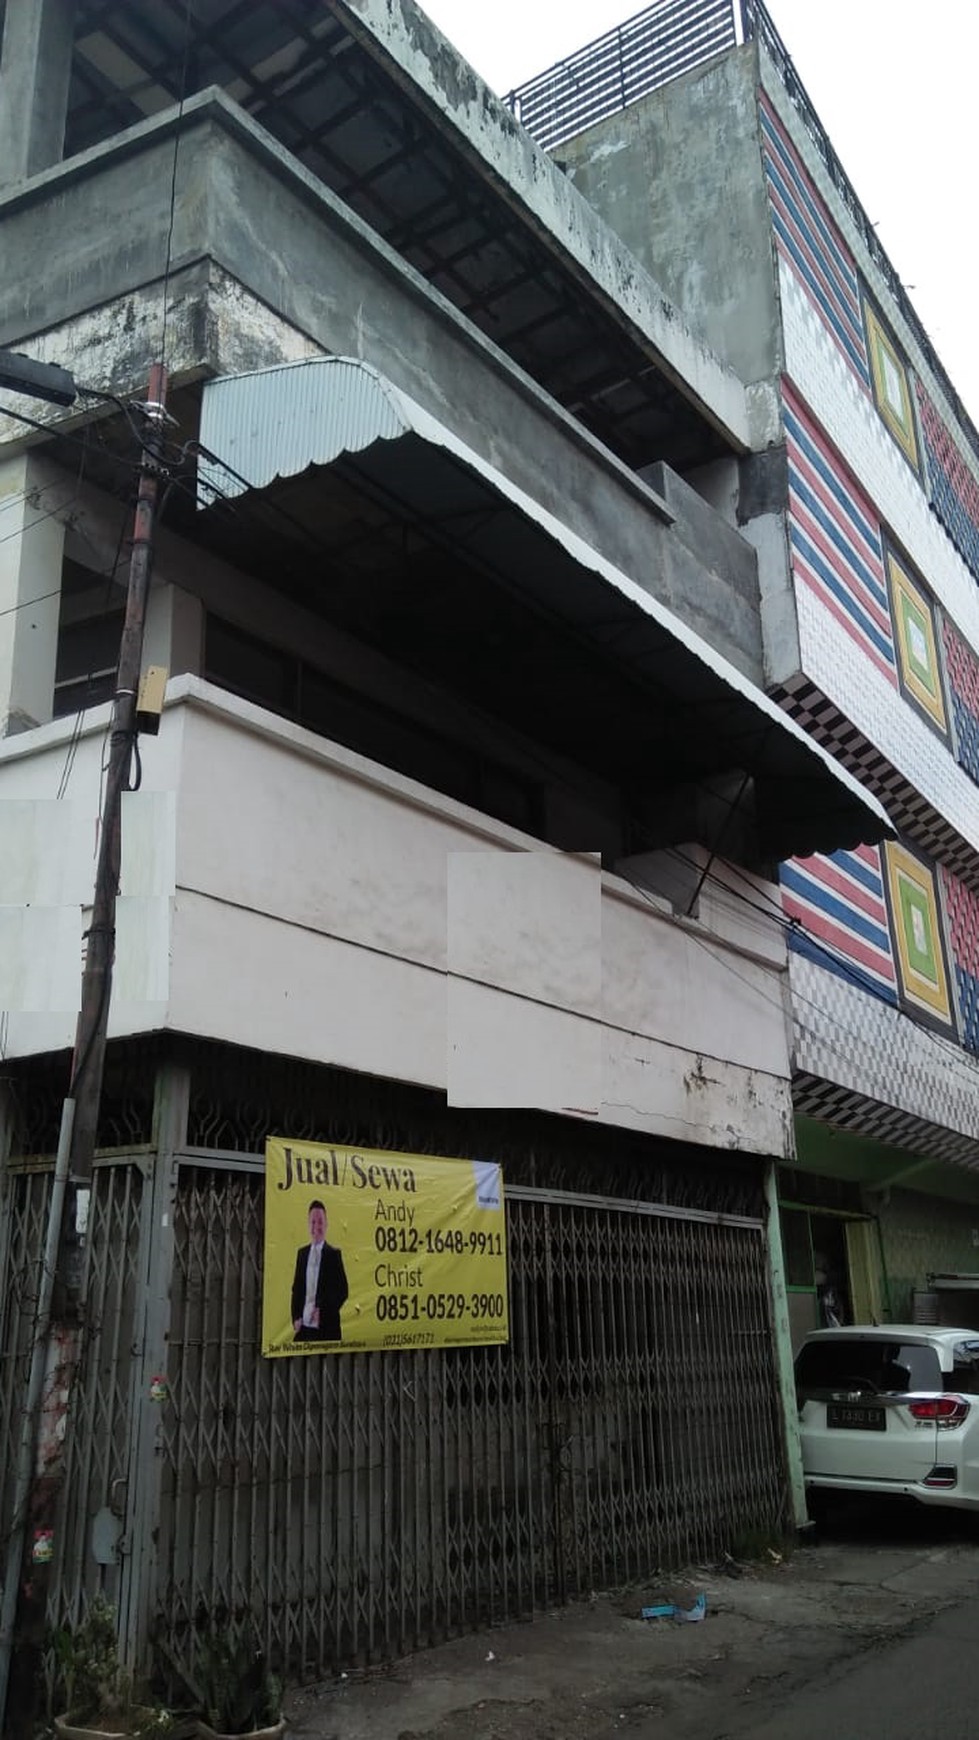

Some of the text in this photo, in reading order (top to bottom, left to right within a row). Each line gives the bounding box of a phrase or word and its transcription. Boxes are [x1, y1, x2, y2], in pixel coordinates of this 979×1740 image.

[278, 1147, 417, 1192] Jual/Sewa
[375, 1198, 415, 1226] Andy
[375, 1226, 502, 1255] 0812-1648-9911
[375, 1264, 423, 1287] Christ
[376, 1294, 503, 1320] 0851-0529-3900
